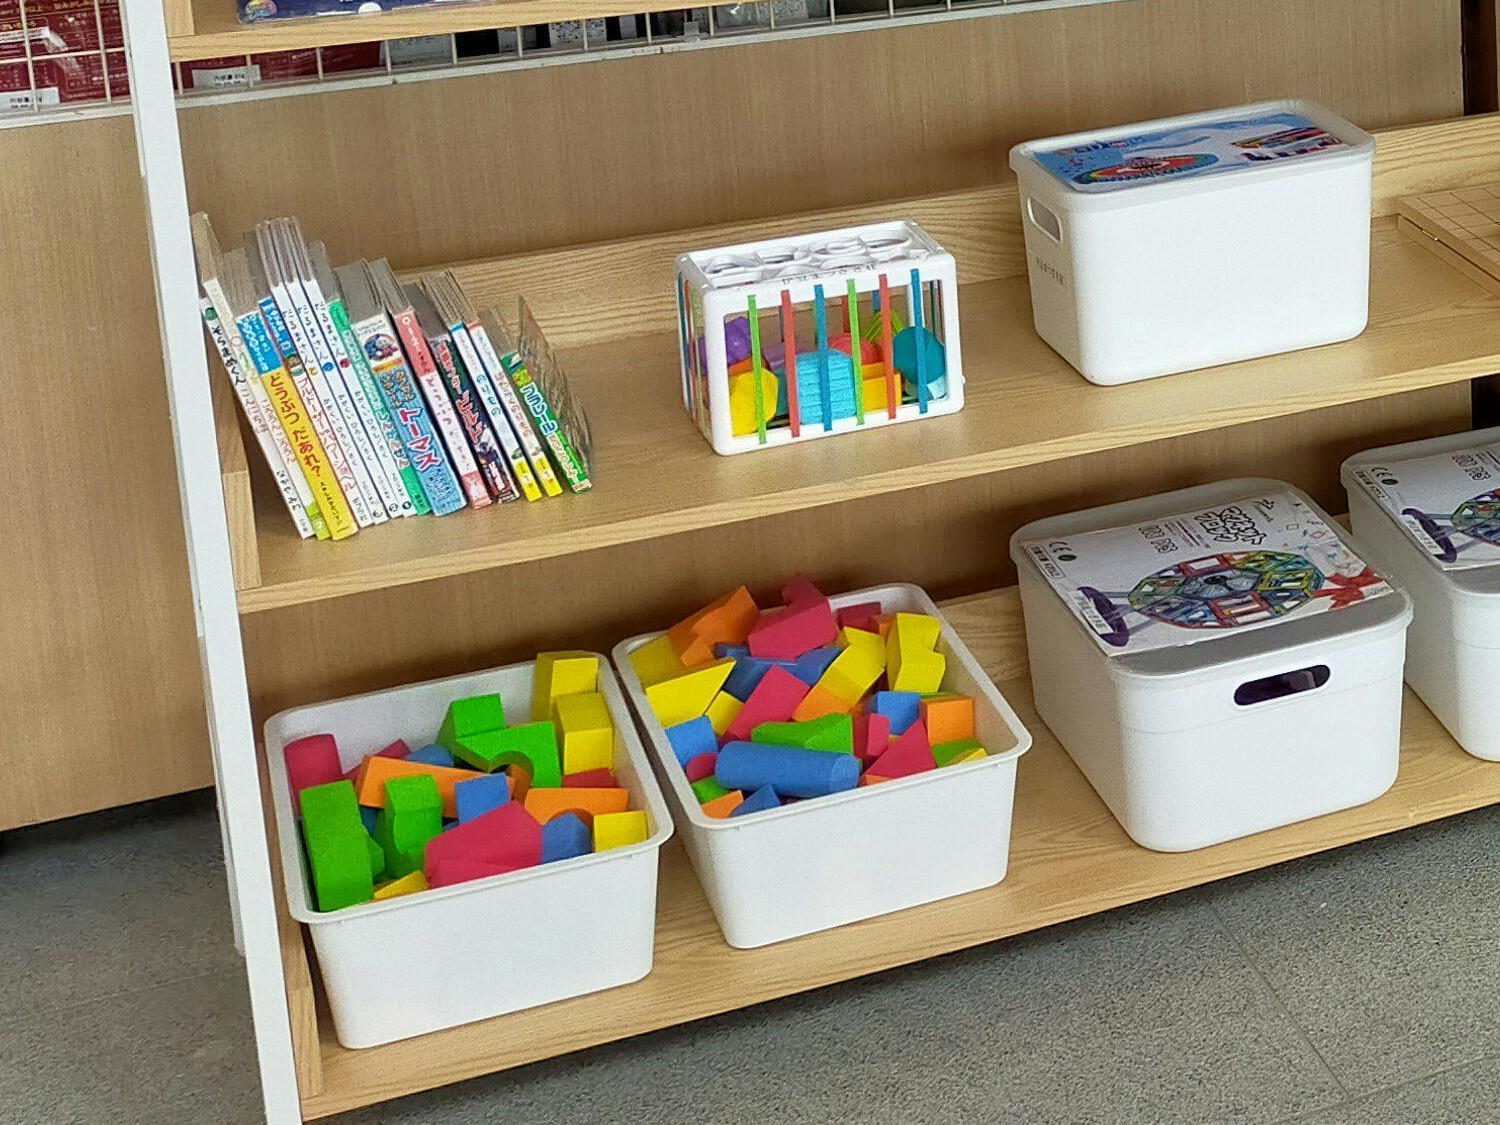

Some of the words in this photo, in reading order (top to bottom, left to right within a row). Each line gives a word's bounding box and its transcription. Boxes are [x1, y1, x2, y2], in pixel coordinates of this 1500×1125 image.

[269, 372, 301, 426] どうぶつ
[399, 406, 442, 473] トーマス
